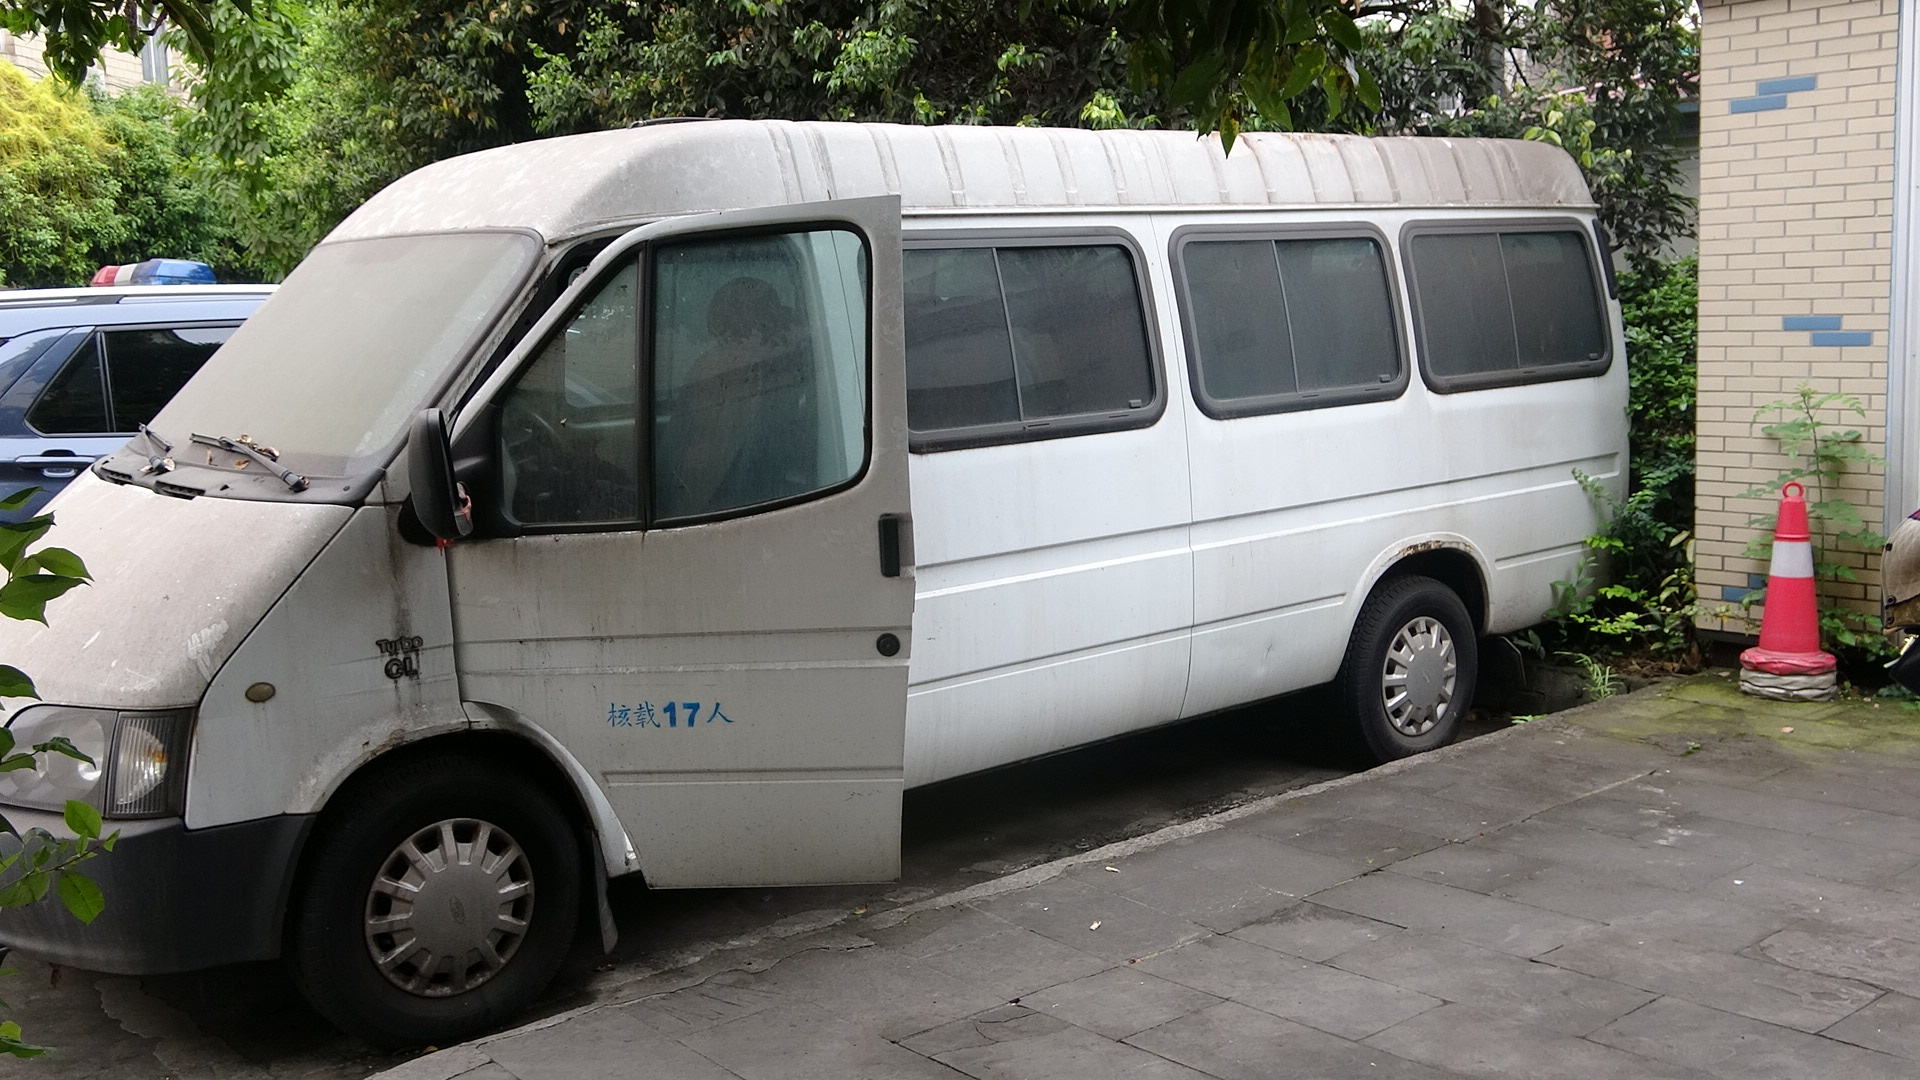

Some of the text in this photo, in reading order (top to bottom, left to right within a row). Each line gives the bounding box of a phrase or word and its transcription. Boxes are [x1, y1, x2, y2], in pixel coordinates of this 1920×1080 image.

[375, 636, 423, 655] Turbo
[607, 701, 734, 728] 核载17人
